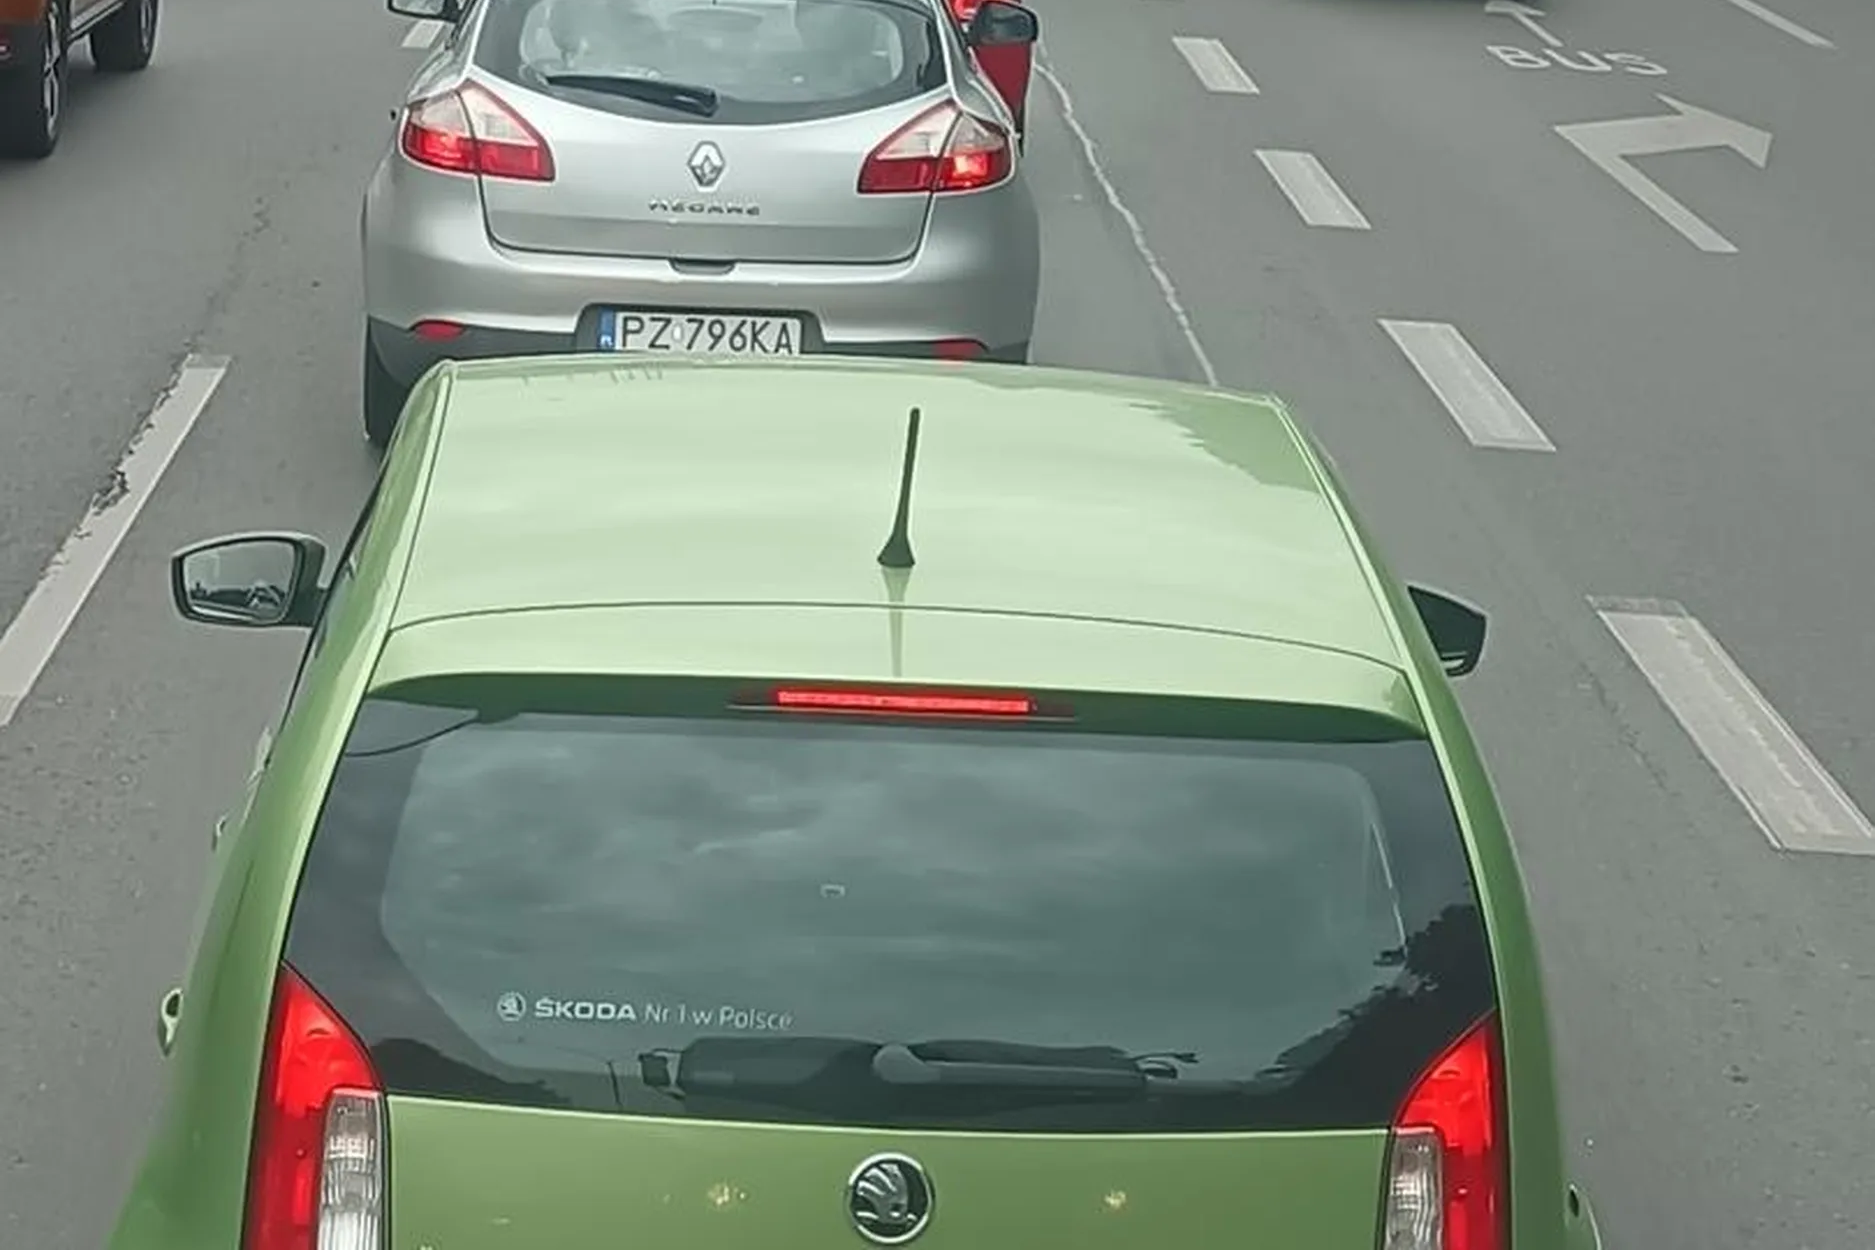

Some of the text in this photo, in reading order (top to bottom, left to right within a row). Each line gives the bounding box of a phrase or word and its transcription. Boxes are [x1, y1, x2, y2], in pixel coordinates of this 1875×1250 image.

[1485, 45, 1668, 75] BUS
[621, 315, 672, 350] PZ
[685, 317, 794, 355] 796KA
[643, 1003, 671, 1024] Nr
[678, 1003, 686, 1024] 1
[693, 1009, 712, 1026] w
[718, 1005, 795, 1031] Polsce
